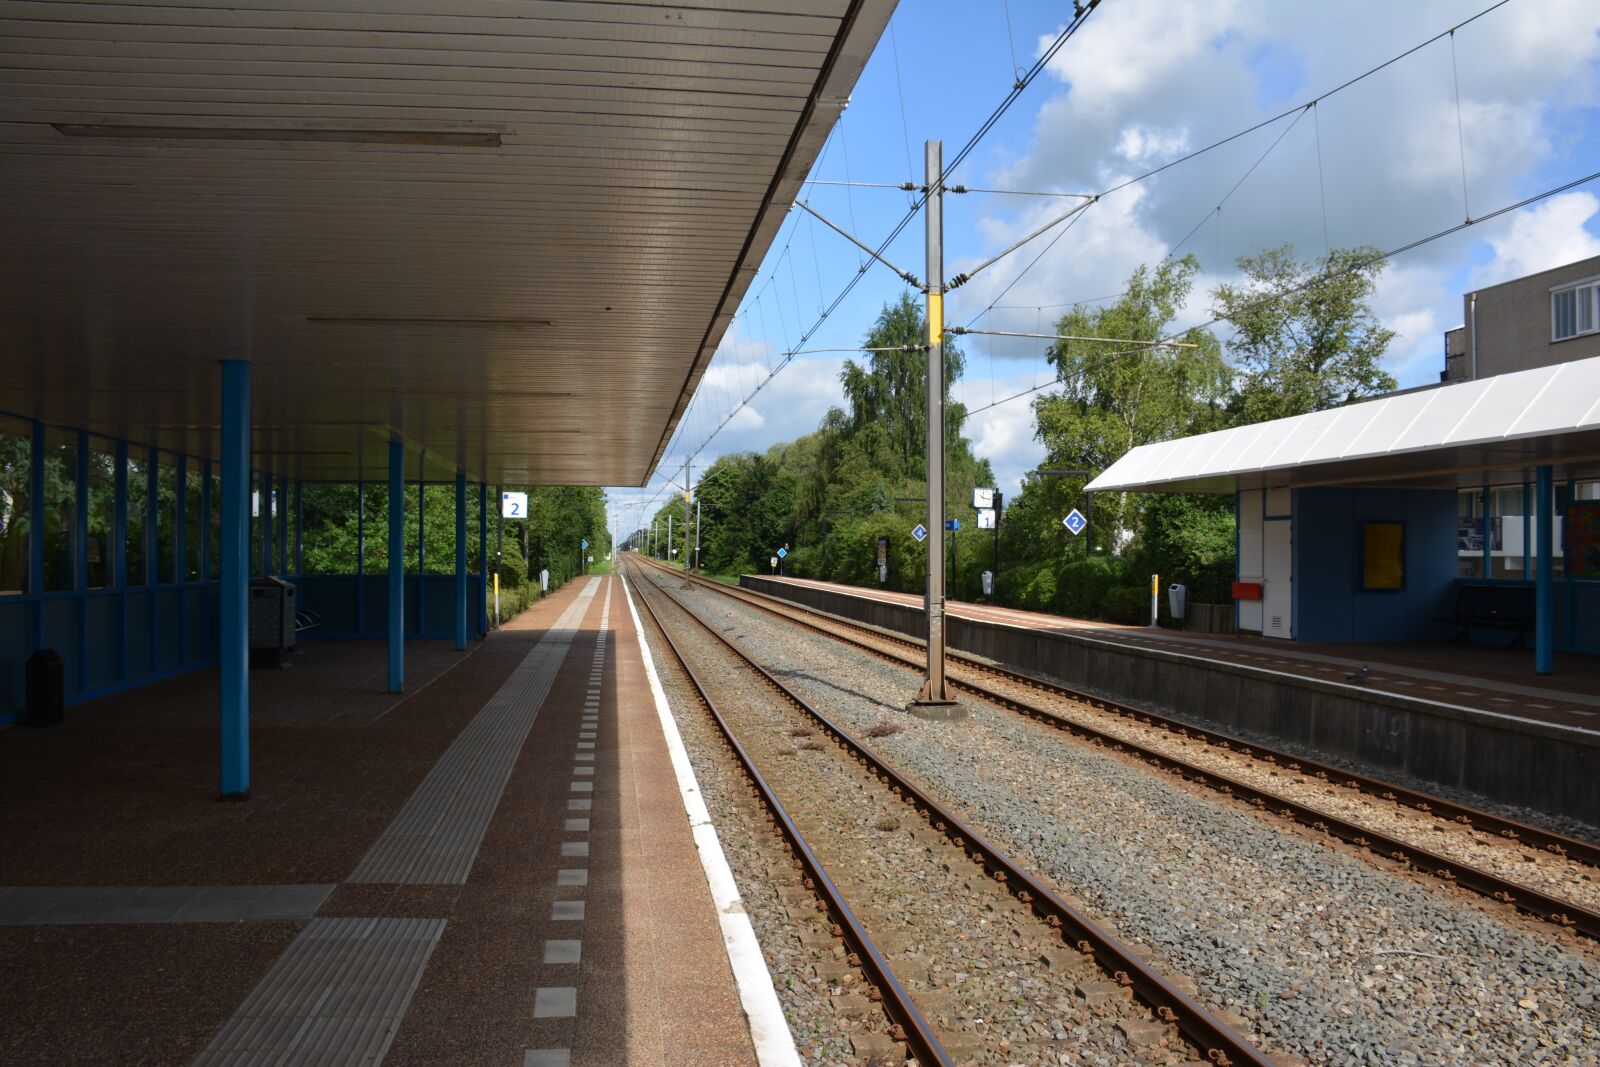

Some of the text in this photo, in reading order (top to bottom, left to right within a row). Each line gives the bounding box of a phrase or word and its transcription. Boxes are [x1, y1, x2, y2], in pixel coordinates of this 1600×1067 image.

[511, 502, 519, 515] 2
[984, 517, 989, 527] 1
[1071, 516, 1079, 527] 2
